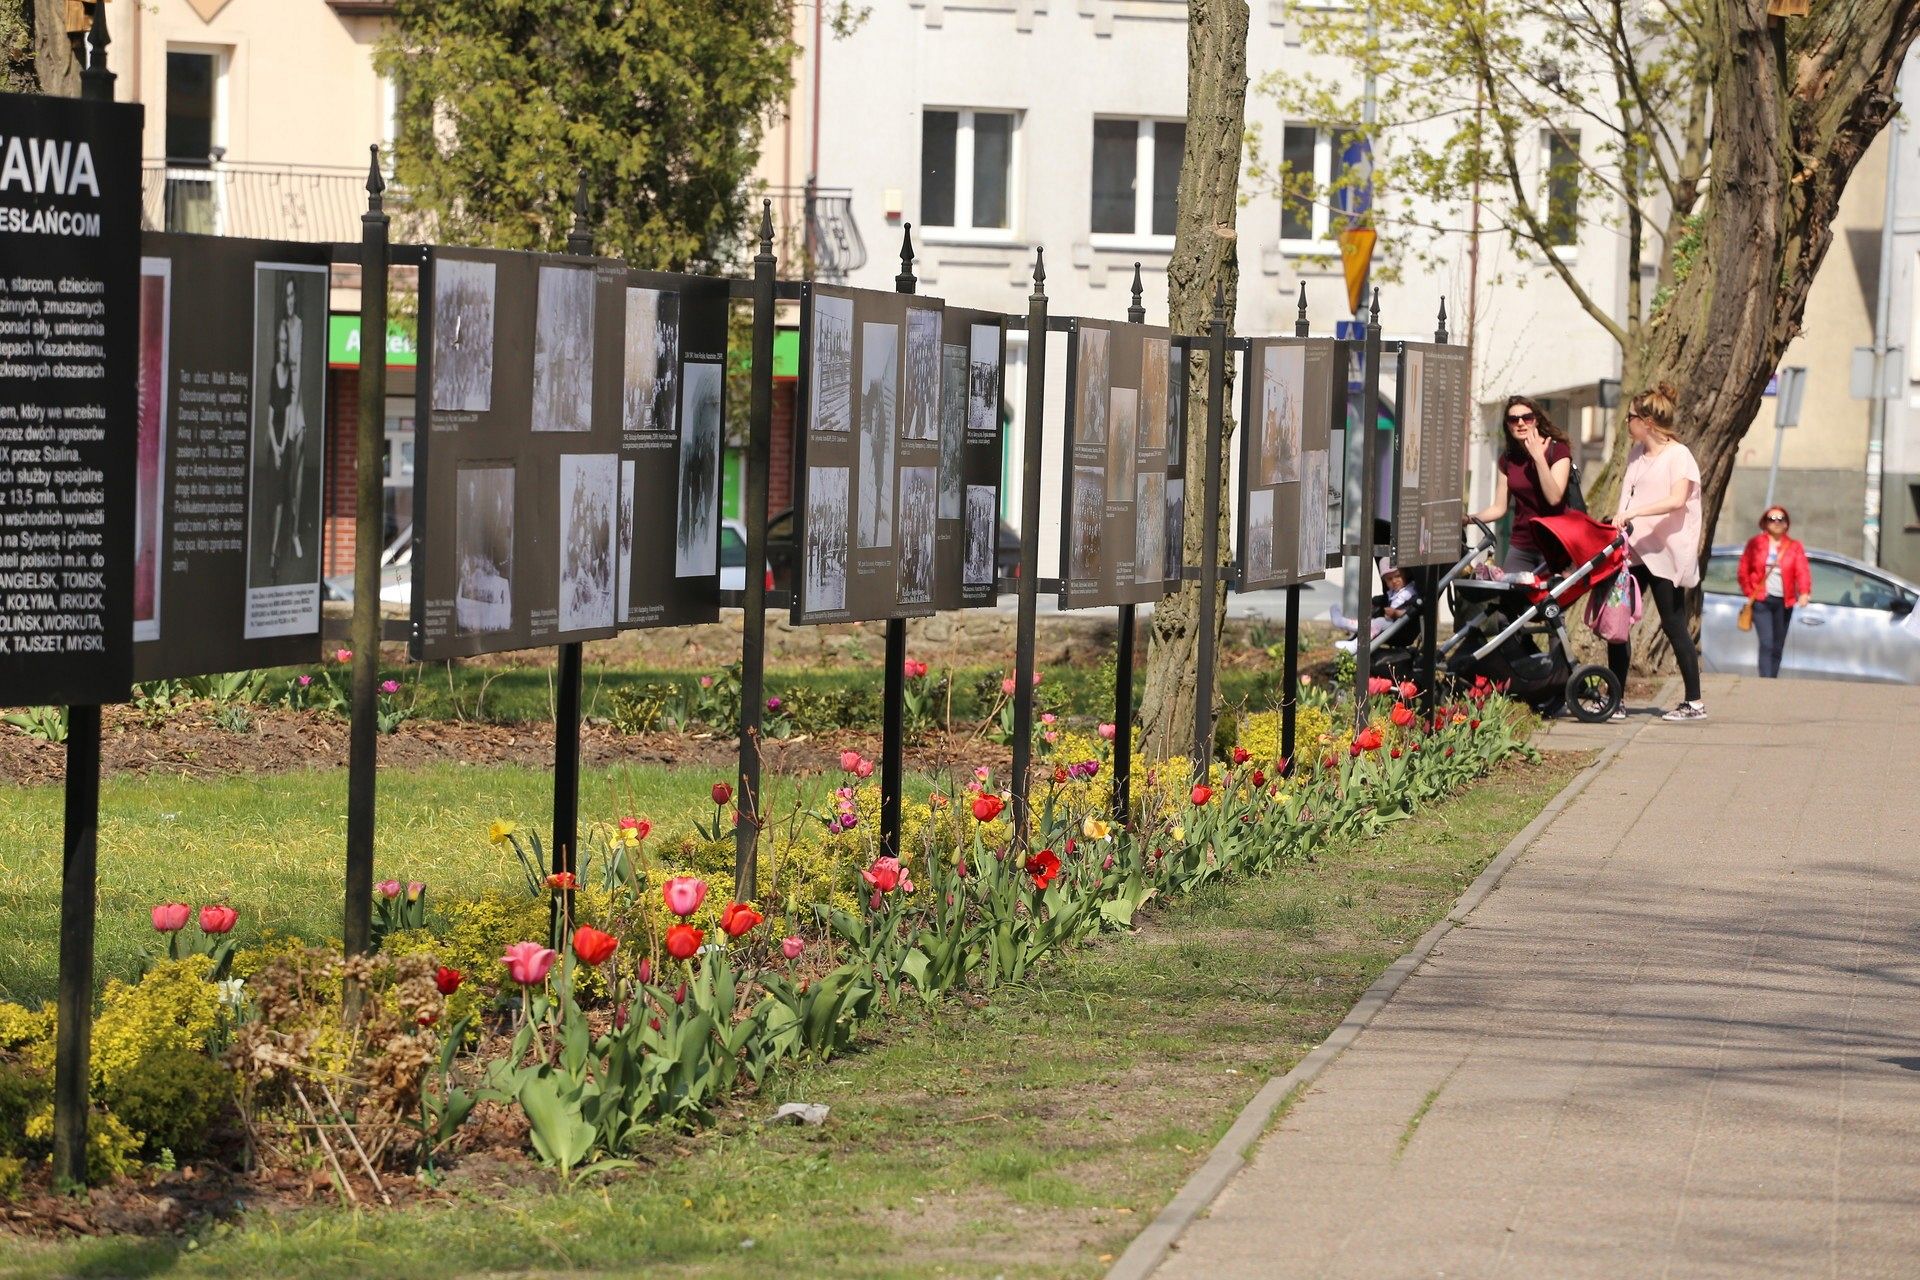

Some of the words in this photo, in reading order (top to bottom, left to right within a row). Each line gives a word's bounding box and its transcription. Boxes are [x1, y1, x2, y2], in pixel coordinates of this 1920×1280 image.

[0, 135, 100, 197] AWA
[0, 204, 100, 237] ESŁAŃCOM
[58, 277, 104, 293] dzieciom
[43, 299, 104, 318] zmuszanych
[54, 320, 105, 336] umierania
[0, 340, 33, 359] epach
[36, 341, 106, 359] Kazachstanu,
[52, 361, 104, 378] obszarach
[21, 403, 45, 423] który
[47, 407, 62, 419] we
[63, 404, 105, 419] wrześniu
[25, 425, 56, 441] dwóch
[57, 425, 105, 444] agresorów
[11, 449, 41, 465] przez
[43, 446, 81, 462] Stalina.
[16, 467, 51, 487] służby
[53, 468, 104, 487] specjalne
[10, 488, 33, 506] 13,5
[61, 488, 104, 504] ludności
[4, 510, 63, 526] wschodnich
[4, 535, 18, 547] na
[20, 530, 60, 550] Syberię
[62, 531, 66, 546] i
[68, 530, 102, 549] północ
[20, 552, 62, 571] polskich
[91, 552, 105, 567] do
[62, 572, 106, 590] TOMSK,
[60, 593, 105, 611] IRKUCK,
